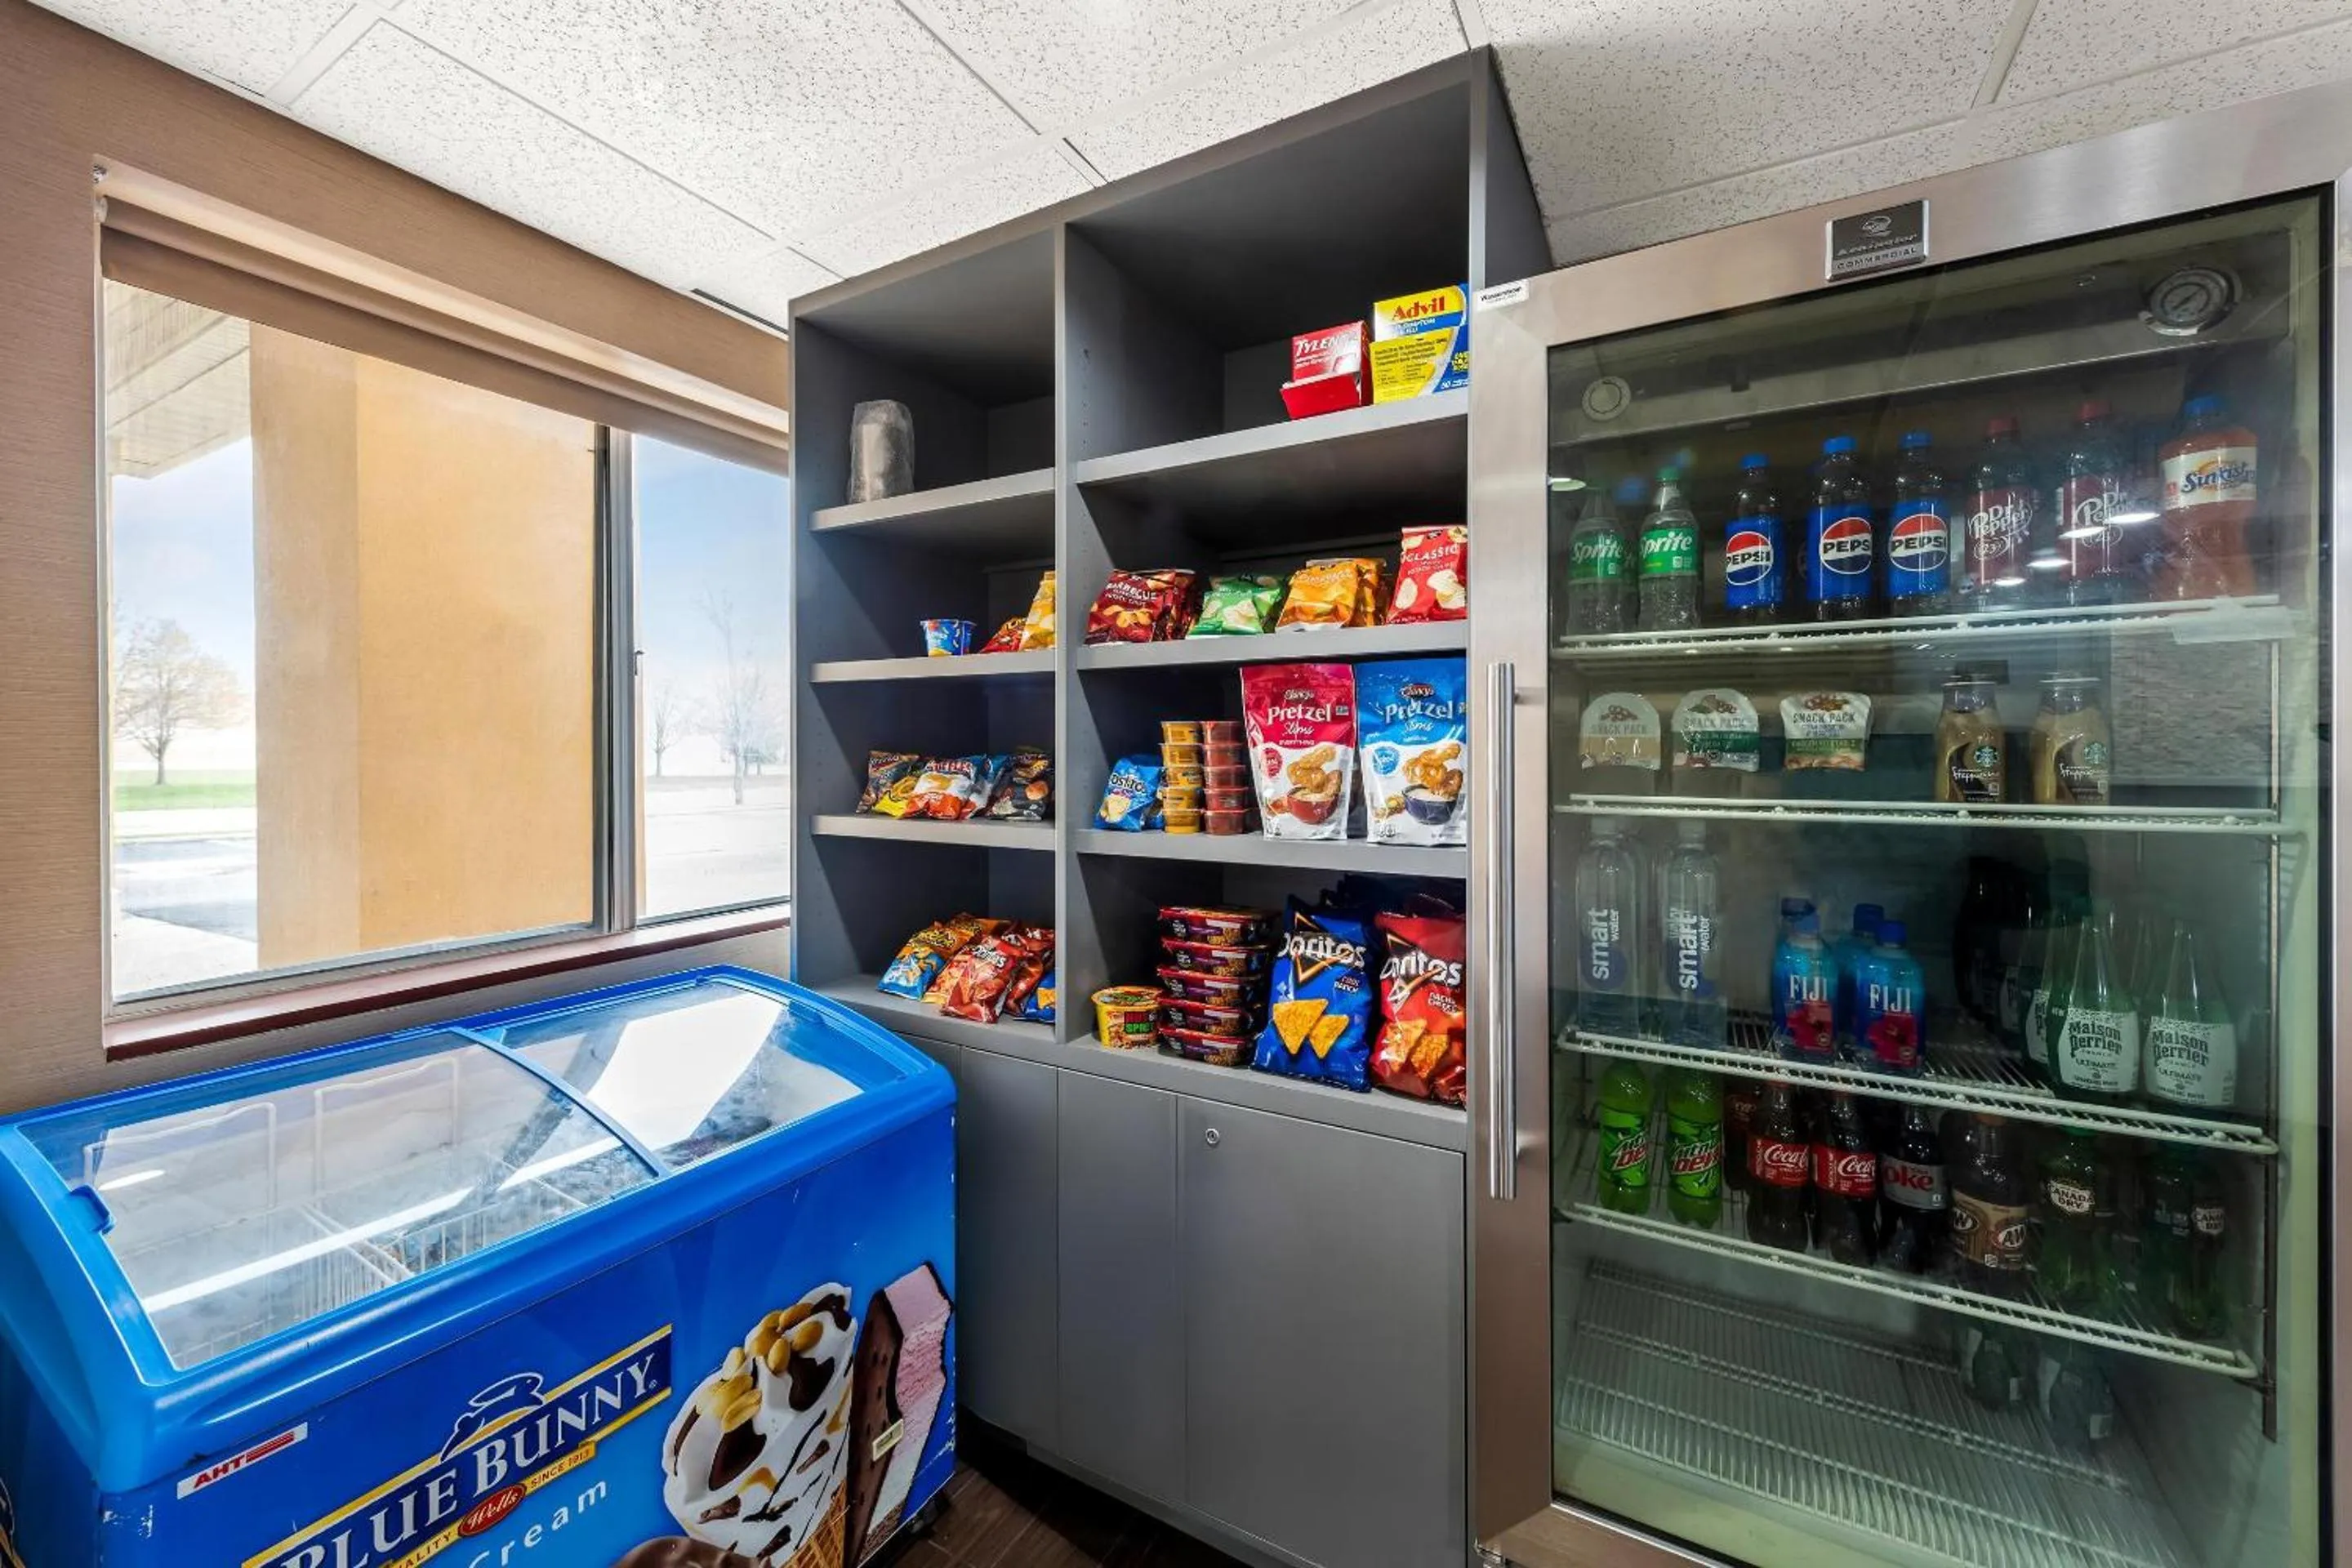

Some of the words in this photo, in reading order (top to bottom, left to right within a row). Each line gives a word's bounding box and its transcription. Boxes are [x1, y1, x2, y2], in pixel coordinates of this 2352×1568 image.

[1837, 247, 1918, 269] COMMERCIAL
[1392, 296, 1445, 321] Advil
[1295, 332, 1351, 357] TYLEN
[1405, 542, 1459, 563] CLASSIC
[1572, 535, 1624, 564] Sprite
[1640, 531, 1693, 559] Sprite
[1892, 535, 1946, 552] PEPSI
[1726, 550, 1771, 567] PEPSI
[1588, 906, 1610, 980] smart
[1678, 911, 1698, 991] smart
[1789, 974, 1828, 1002] FIJI
[1869, 983, 1911, 1013] FIJI
[2069, 1020, 2121, 1042] Maison
[2151, 1029, 2208, 1054] Maison
[1884, 1164, 1934, 1192] oke
[2051, 1187, 2095, 1205] ANADA
[473, 1352, 655, 1499] BUNNY
[194, 1454, 245, 1489] AHT
[530, 1462, 565, 1489] SINCE
[466, 1489, 519, 1530] Wells
[398, 1531, 452, 1568] ALITY
